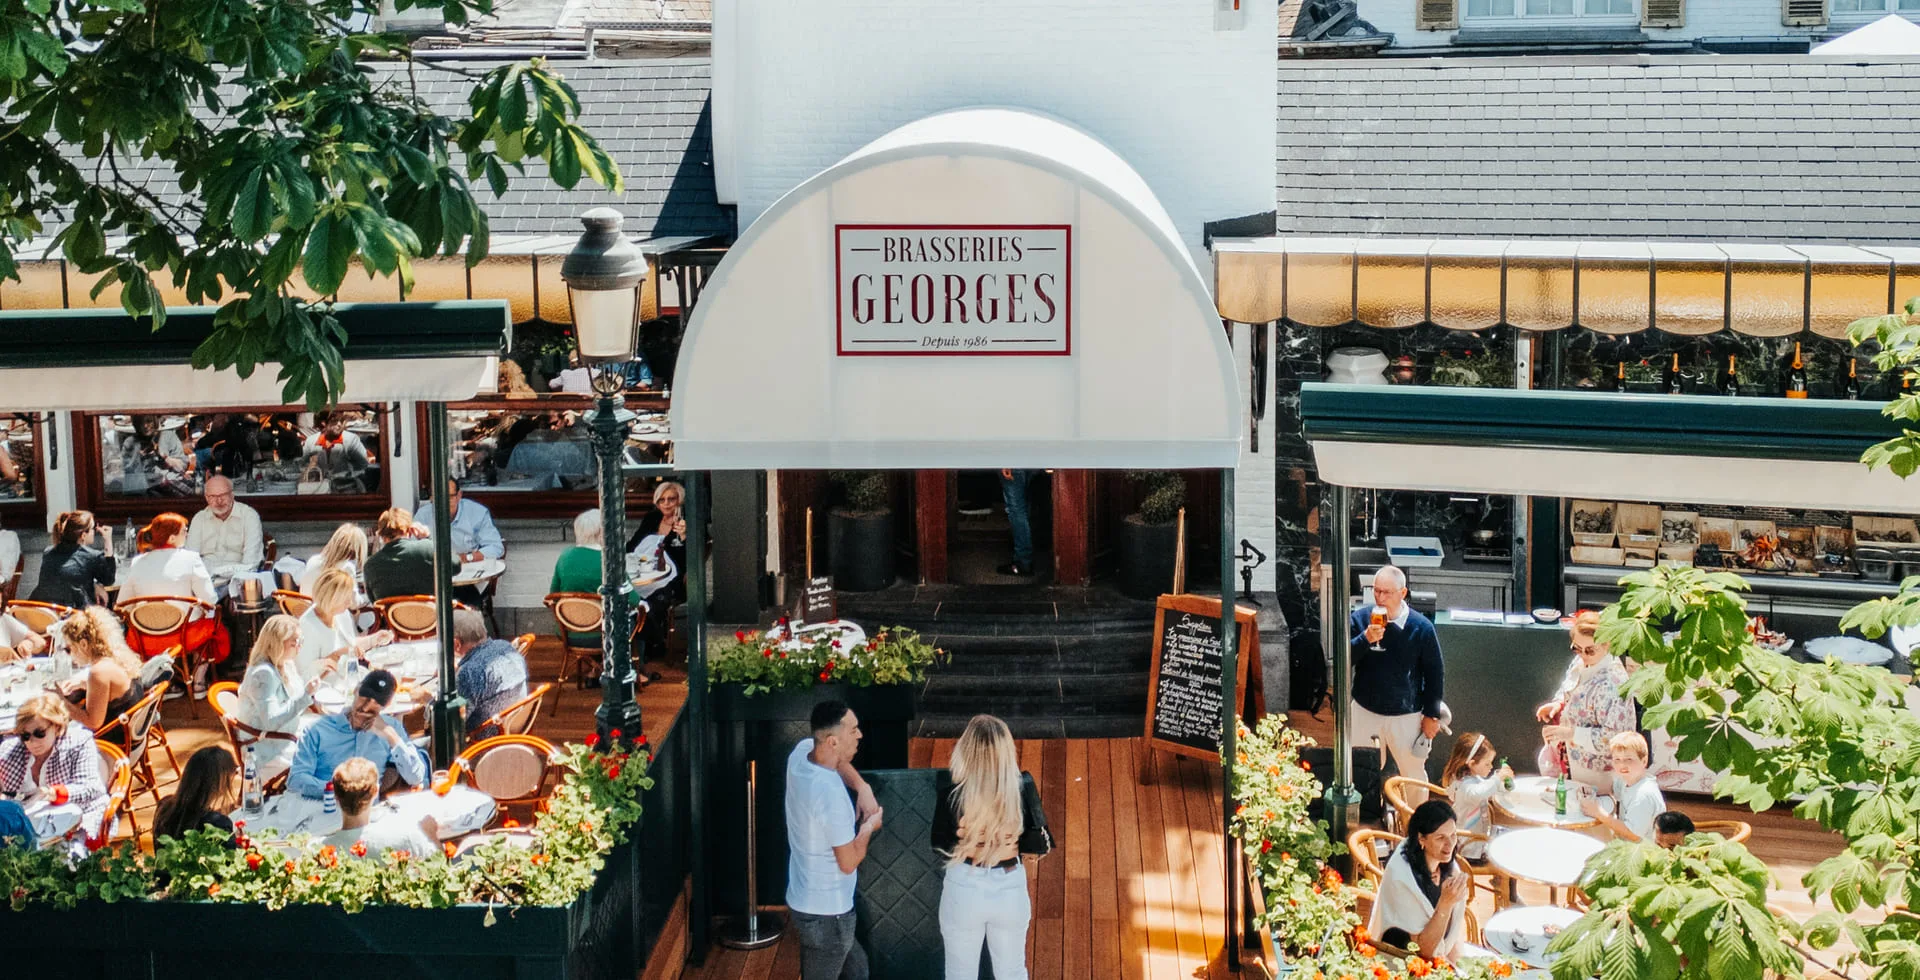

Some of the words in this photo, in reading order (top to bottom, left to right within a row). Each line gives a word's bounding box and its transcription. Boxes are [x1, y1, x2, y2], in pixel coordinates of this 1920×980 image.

[883, 236, 1023, 263] BRASSERIES
[851, 273, 1056, 325] GEORGES
[921, 335, 961, 349] Depuis
[963, 336, 988, 348] 1986
